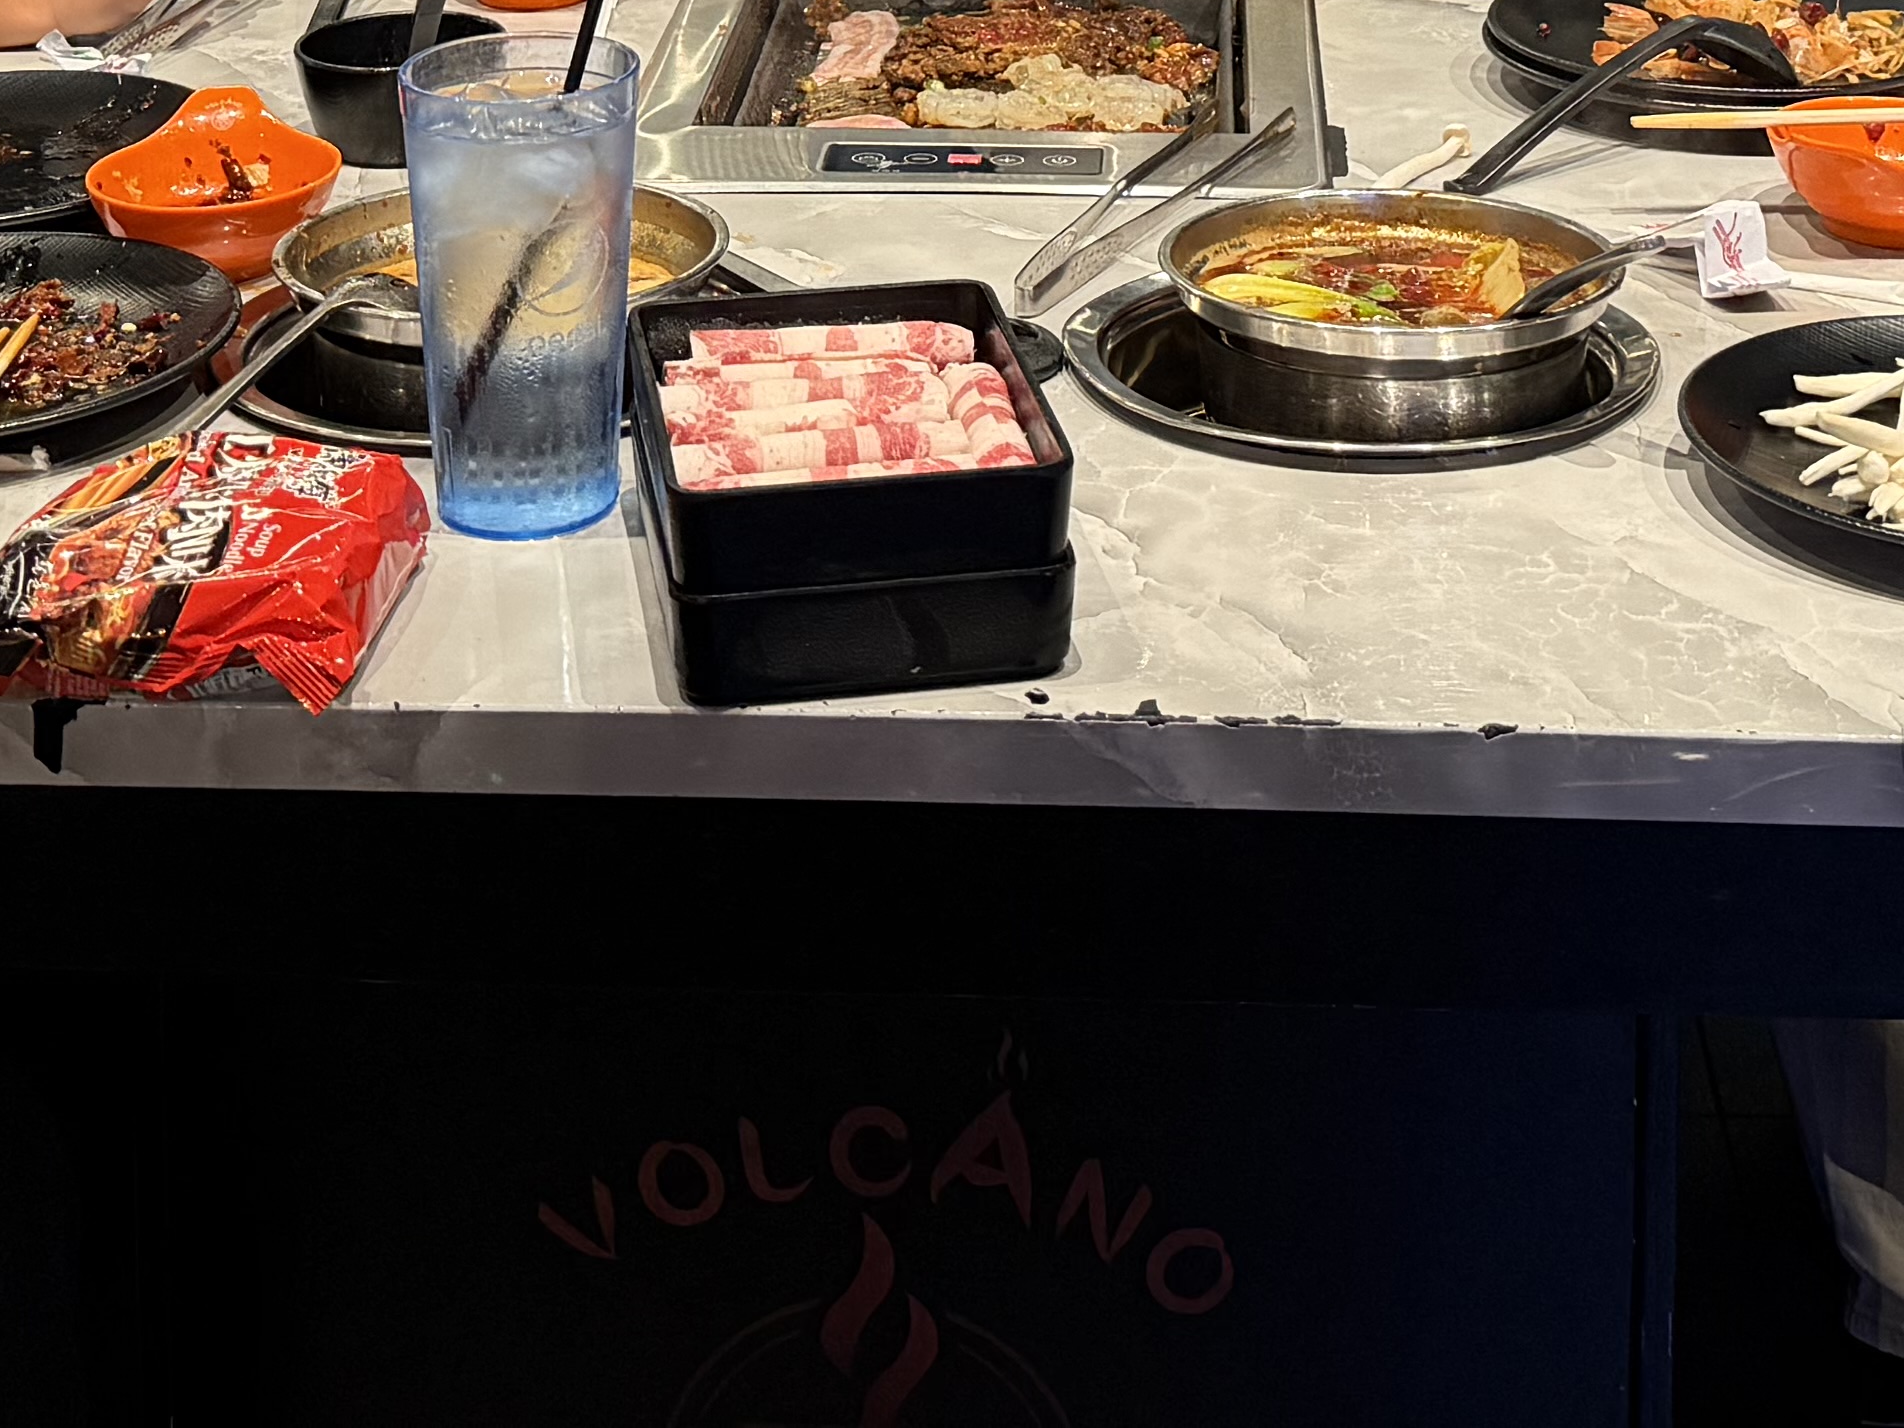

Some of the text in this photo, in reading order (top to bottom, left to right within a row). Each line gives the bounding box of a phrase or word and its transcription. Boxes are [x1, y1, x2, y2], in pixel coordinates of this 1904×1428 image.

[116, 523, 153, 582] Flavor
[248, 523, 282, 558] Soup
[537, 1089, 1235, 1315] VOLCANO
